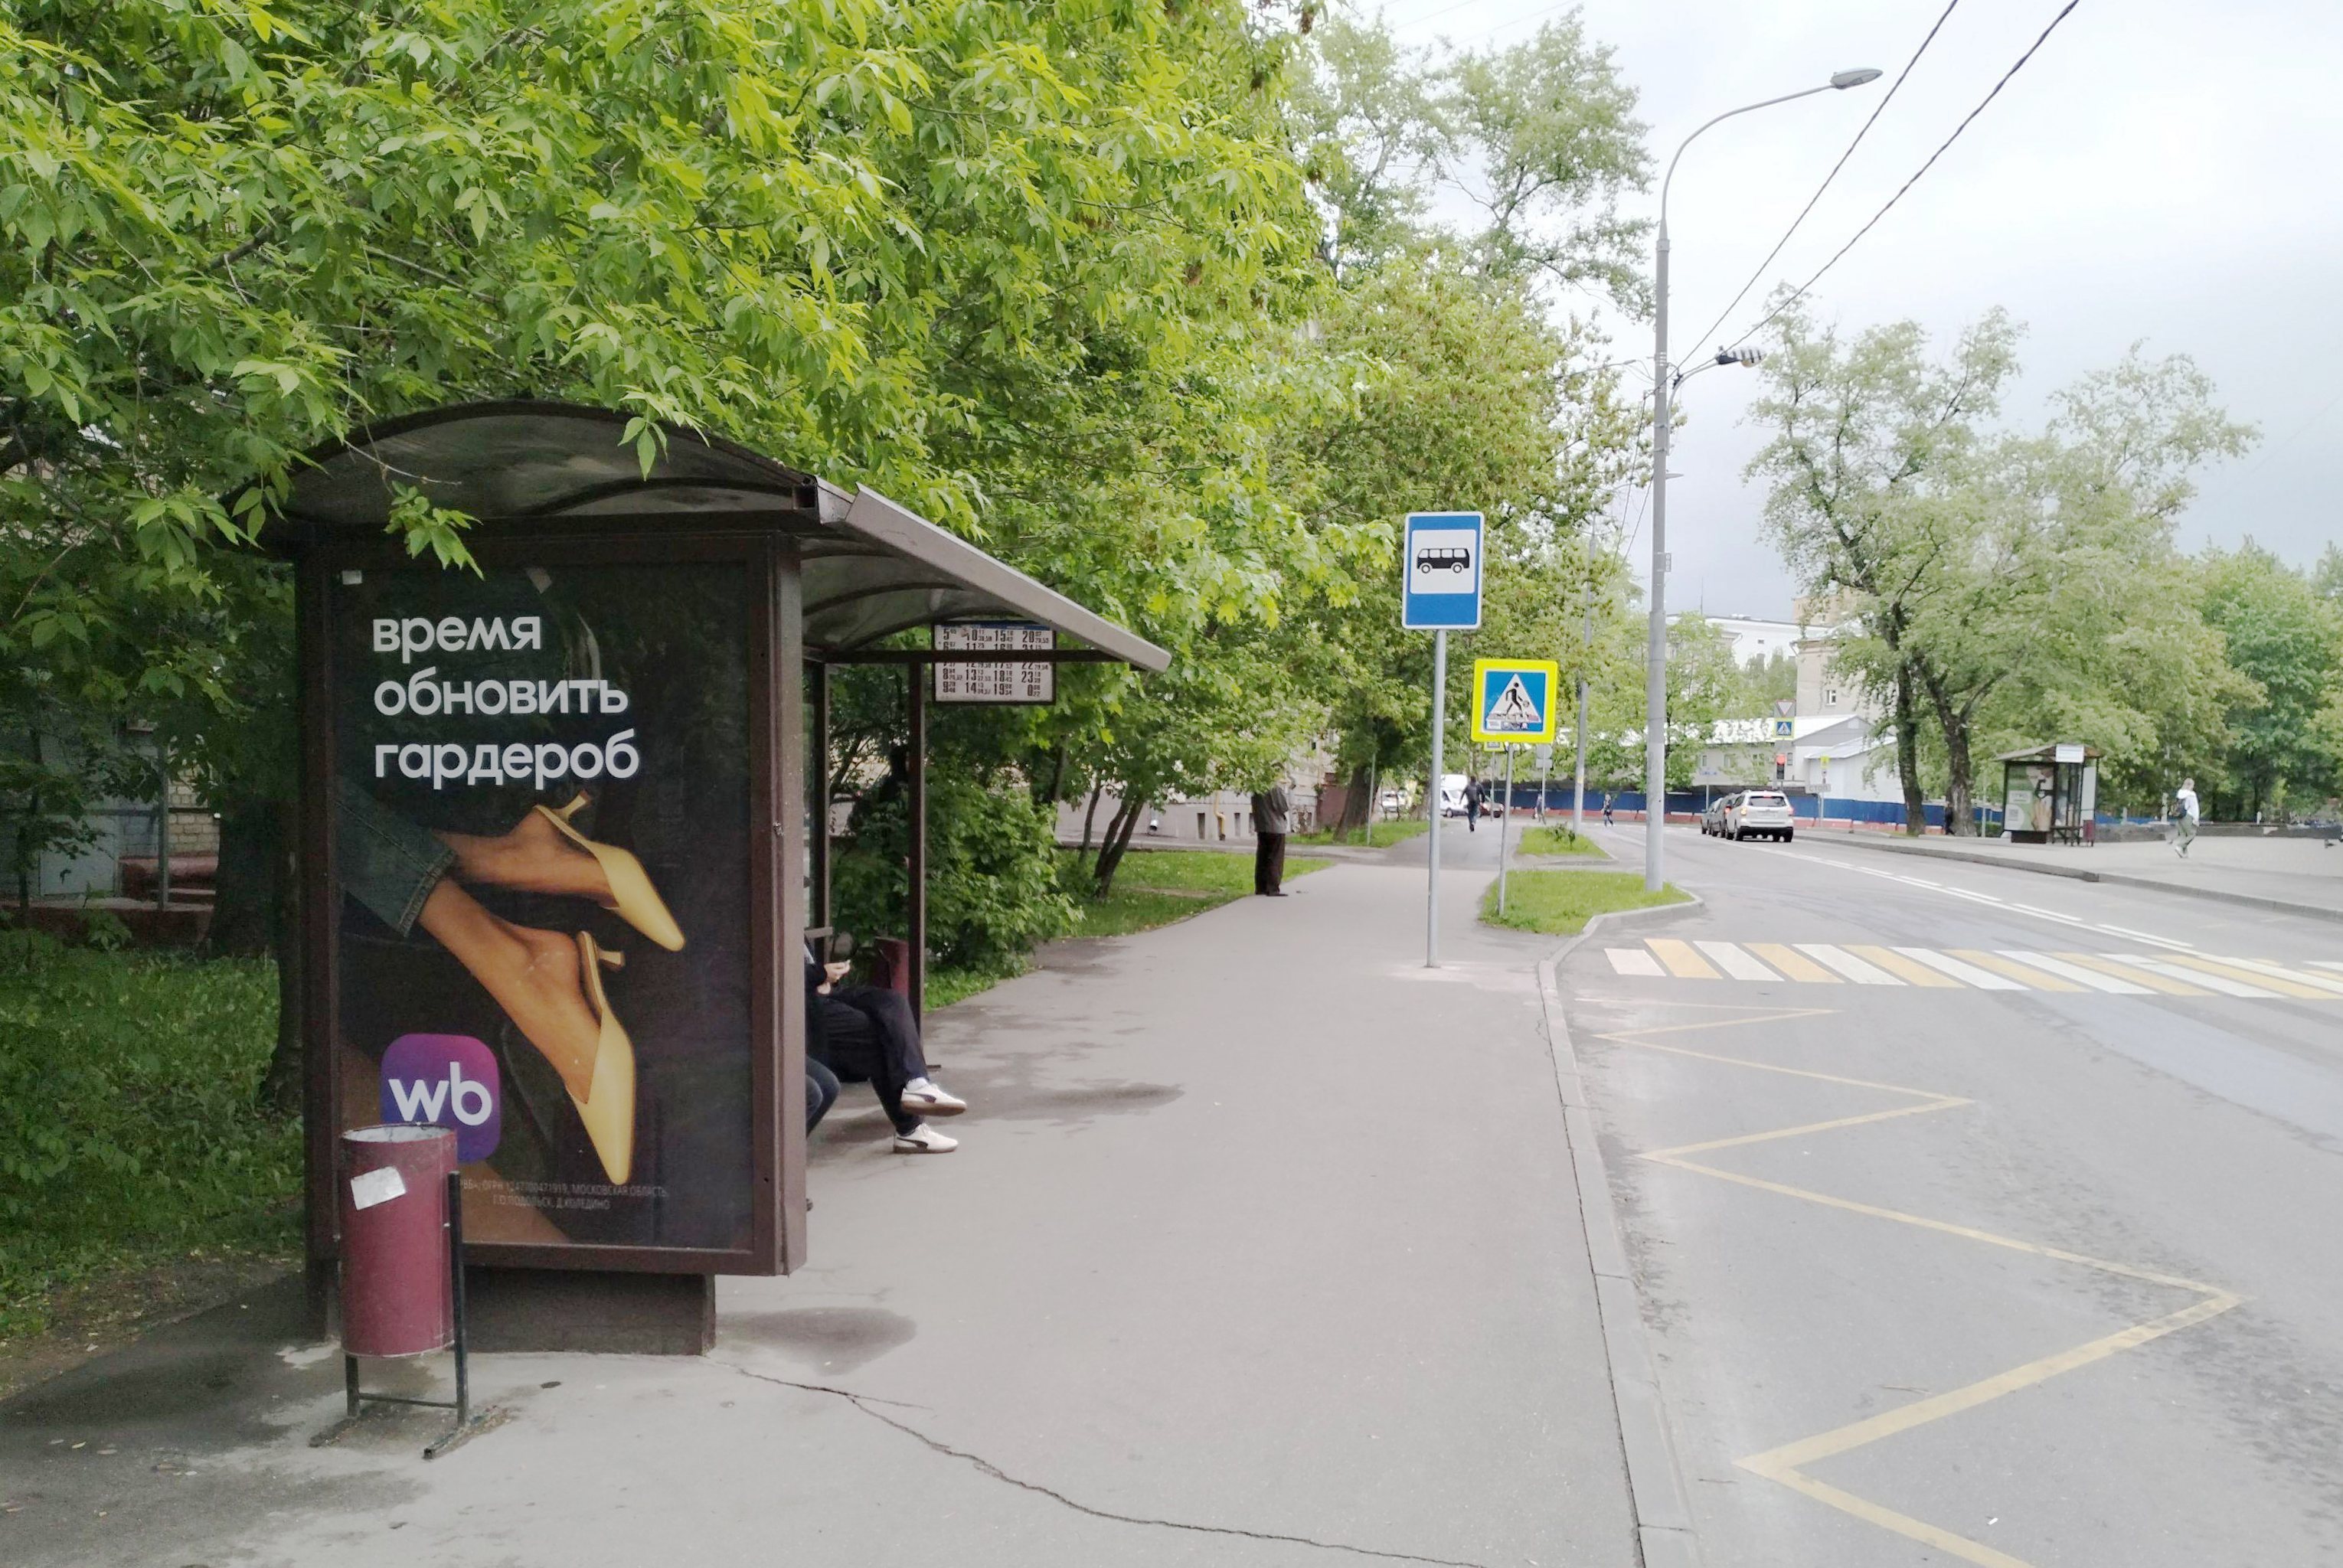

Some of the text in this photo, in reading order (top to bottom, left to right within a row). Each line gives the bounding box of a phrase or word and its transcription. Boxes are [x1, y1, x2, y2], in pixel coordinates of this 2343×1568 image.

[372, 616, 541, 664] время
[943, 628, 949, 640] 5
[995, 630, 1005, 642] 15
[1022, 630, 1034, 643] 20
[966, 669, 977, 681] 13
[994, 670, 1005, 682] 18
[1021, 671, 1033, 683] 23
[374, 666, 629, 715] обновить
[966, 682, 977, 694] 14
[994, 683, 1005, 695] 19
[375, 727, 640, 790] гардероб
[387, 1061, 493, 1126] wb
